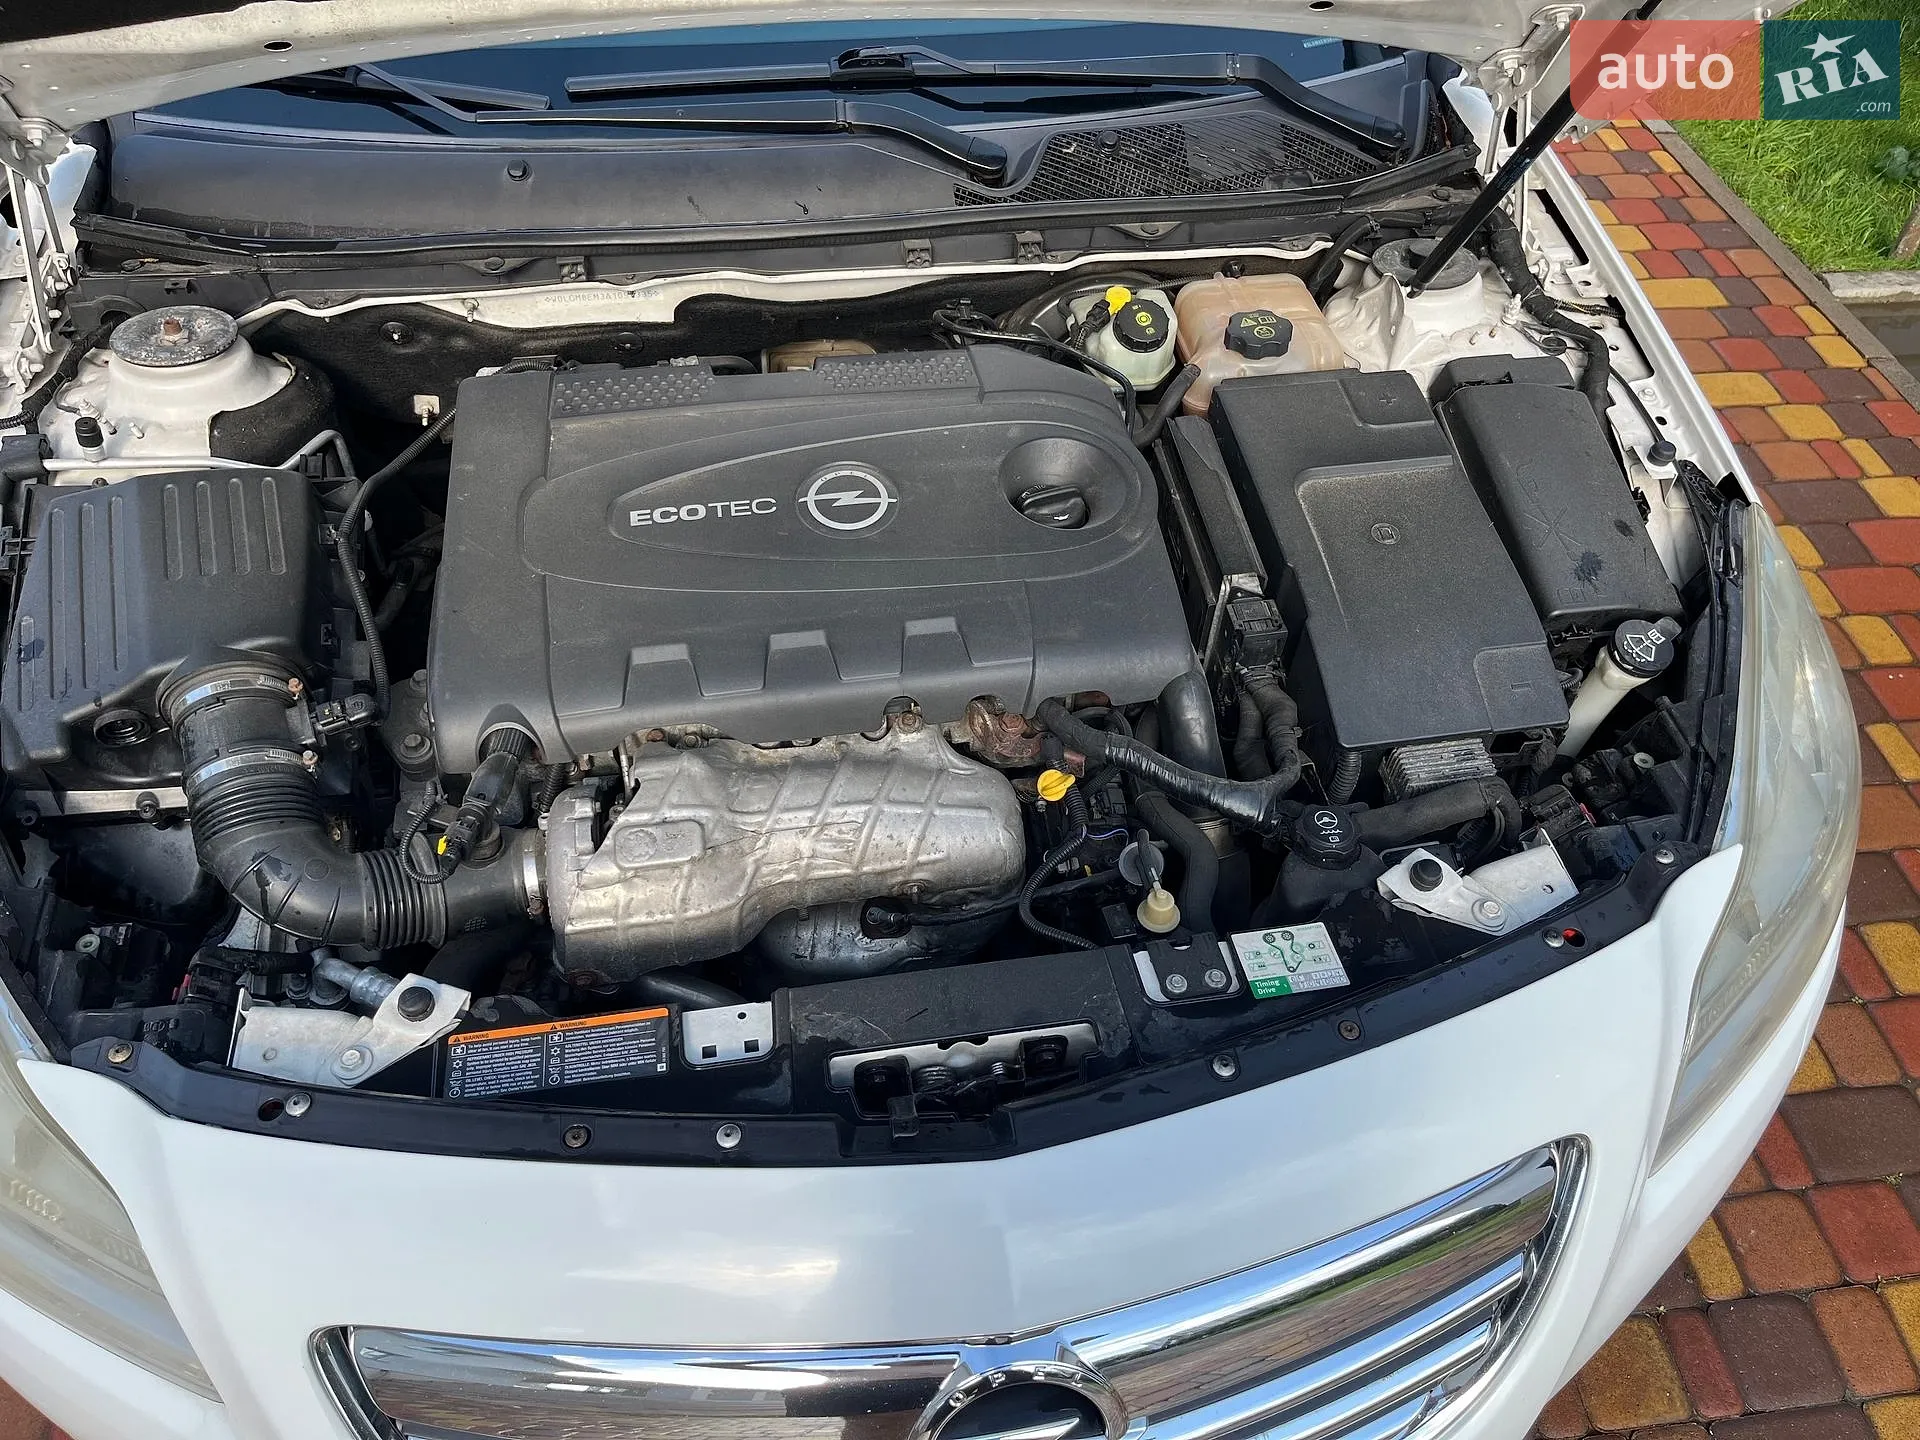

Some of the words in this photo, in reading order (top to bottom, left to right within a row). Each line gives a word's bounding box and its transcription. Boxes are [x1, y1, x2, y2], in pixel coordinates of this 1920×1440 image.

[629, 497, 777, 527] ECOTEC
[1254, 979, 1281, 988] Timing
[1257, 986, 1276, 995] Drive
[463, 1033, 489, 1041] WARNING
[947, 1366, 1083, 1408] OPEL
